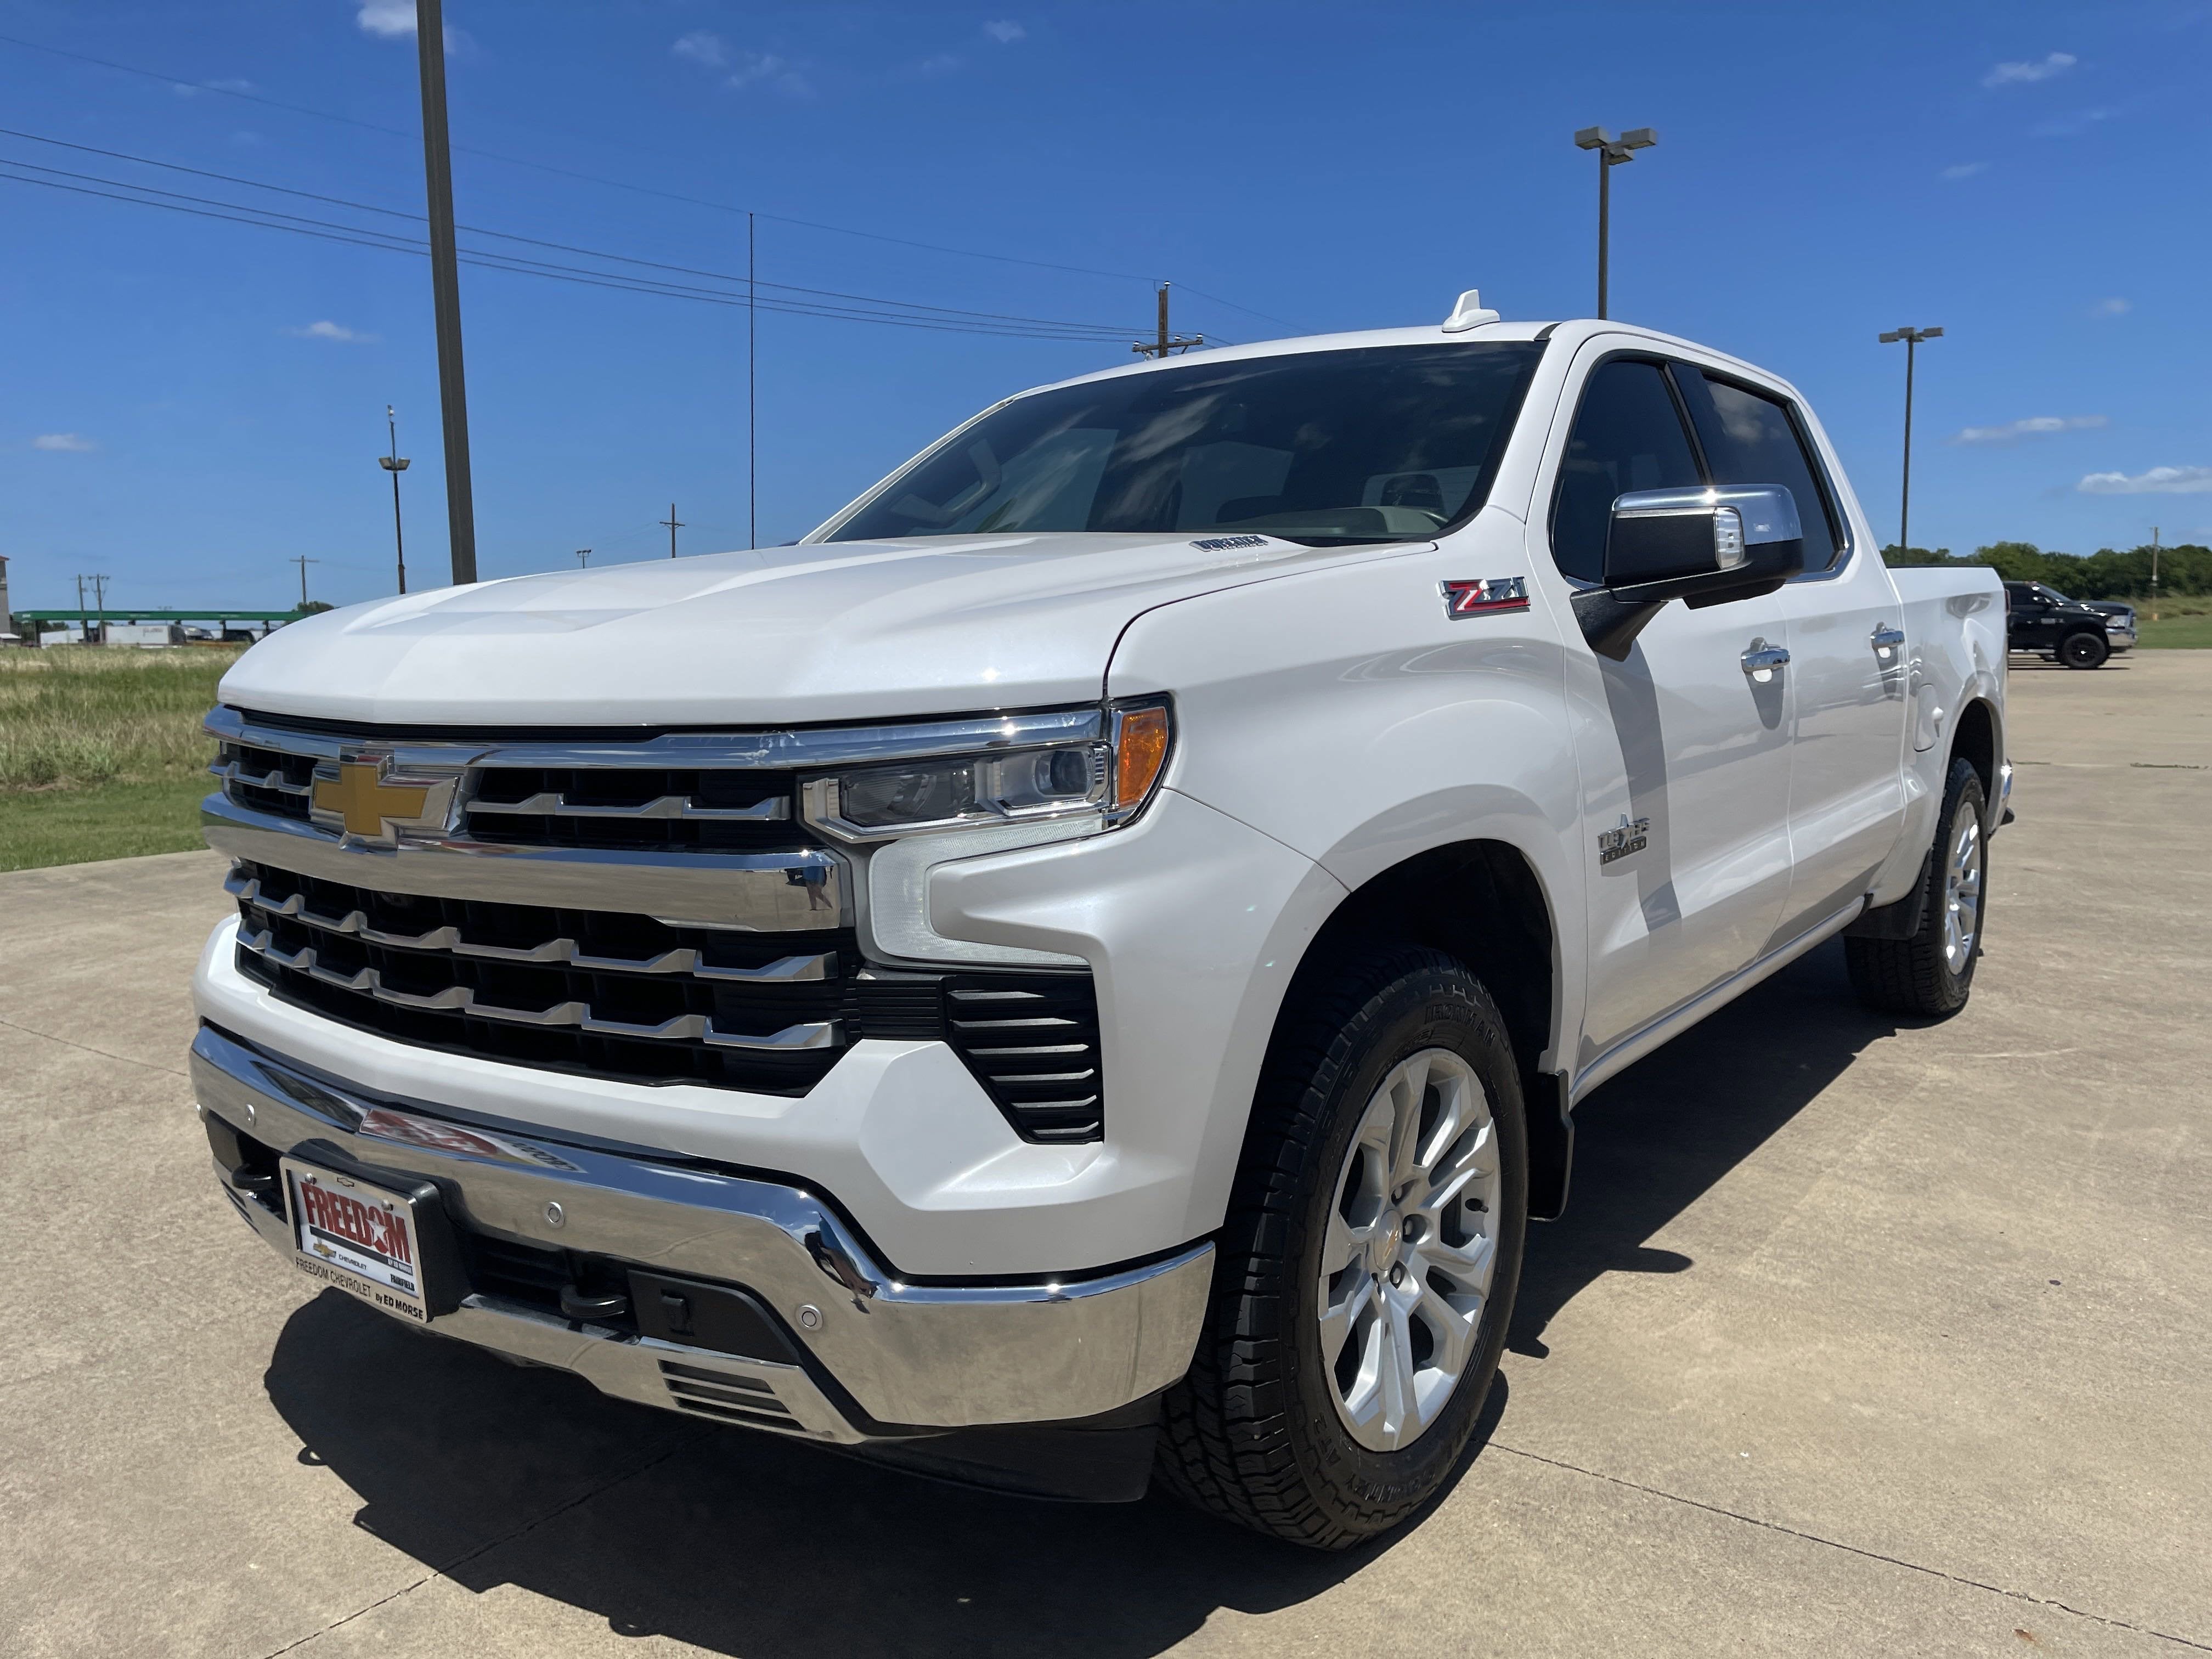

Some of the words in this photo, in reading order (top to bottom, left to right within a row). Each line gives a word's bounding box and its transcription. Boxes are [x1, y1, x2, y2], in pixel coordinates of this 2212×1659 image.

[1440, 576, 1530, 618] Z71
[300, 1182, 411, 1264] FREEDOM
[296, 1256, 329, 1281] FREEDOM
[330, 1270, 371, 1297] CHEVROLET
[383, 1294, 394, 1307] ED
[396, 1299, 424, 1320] MORSE
